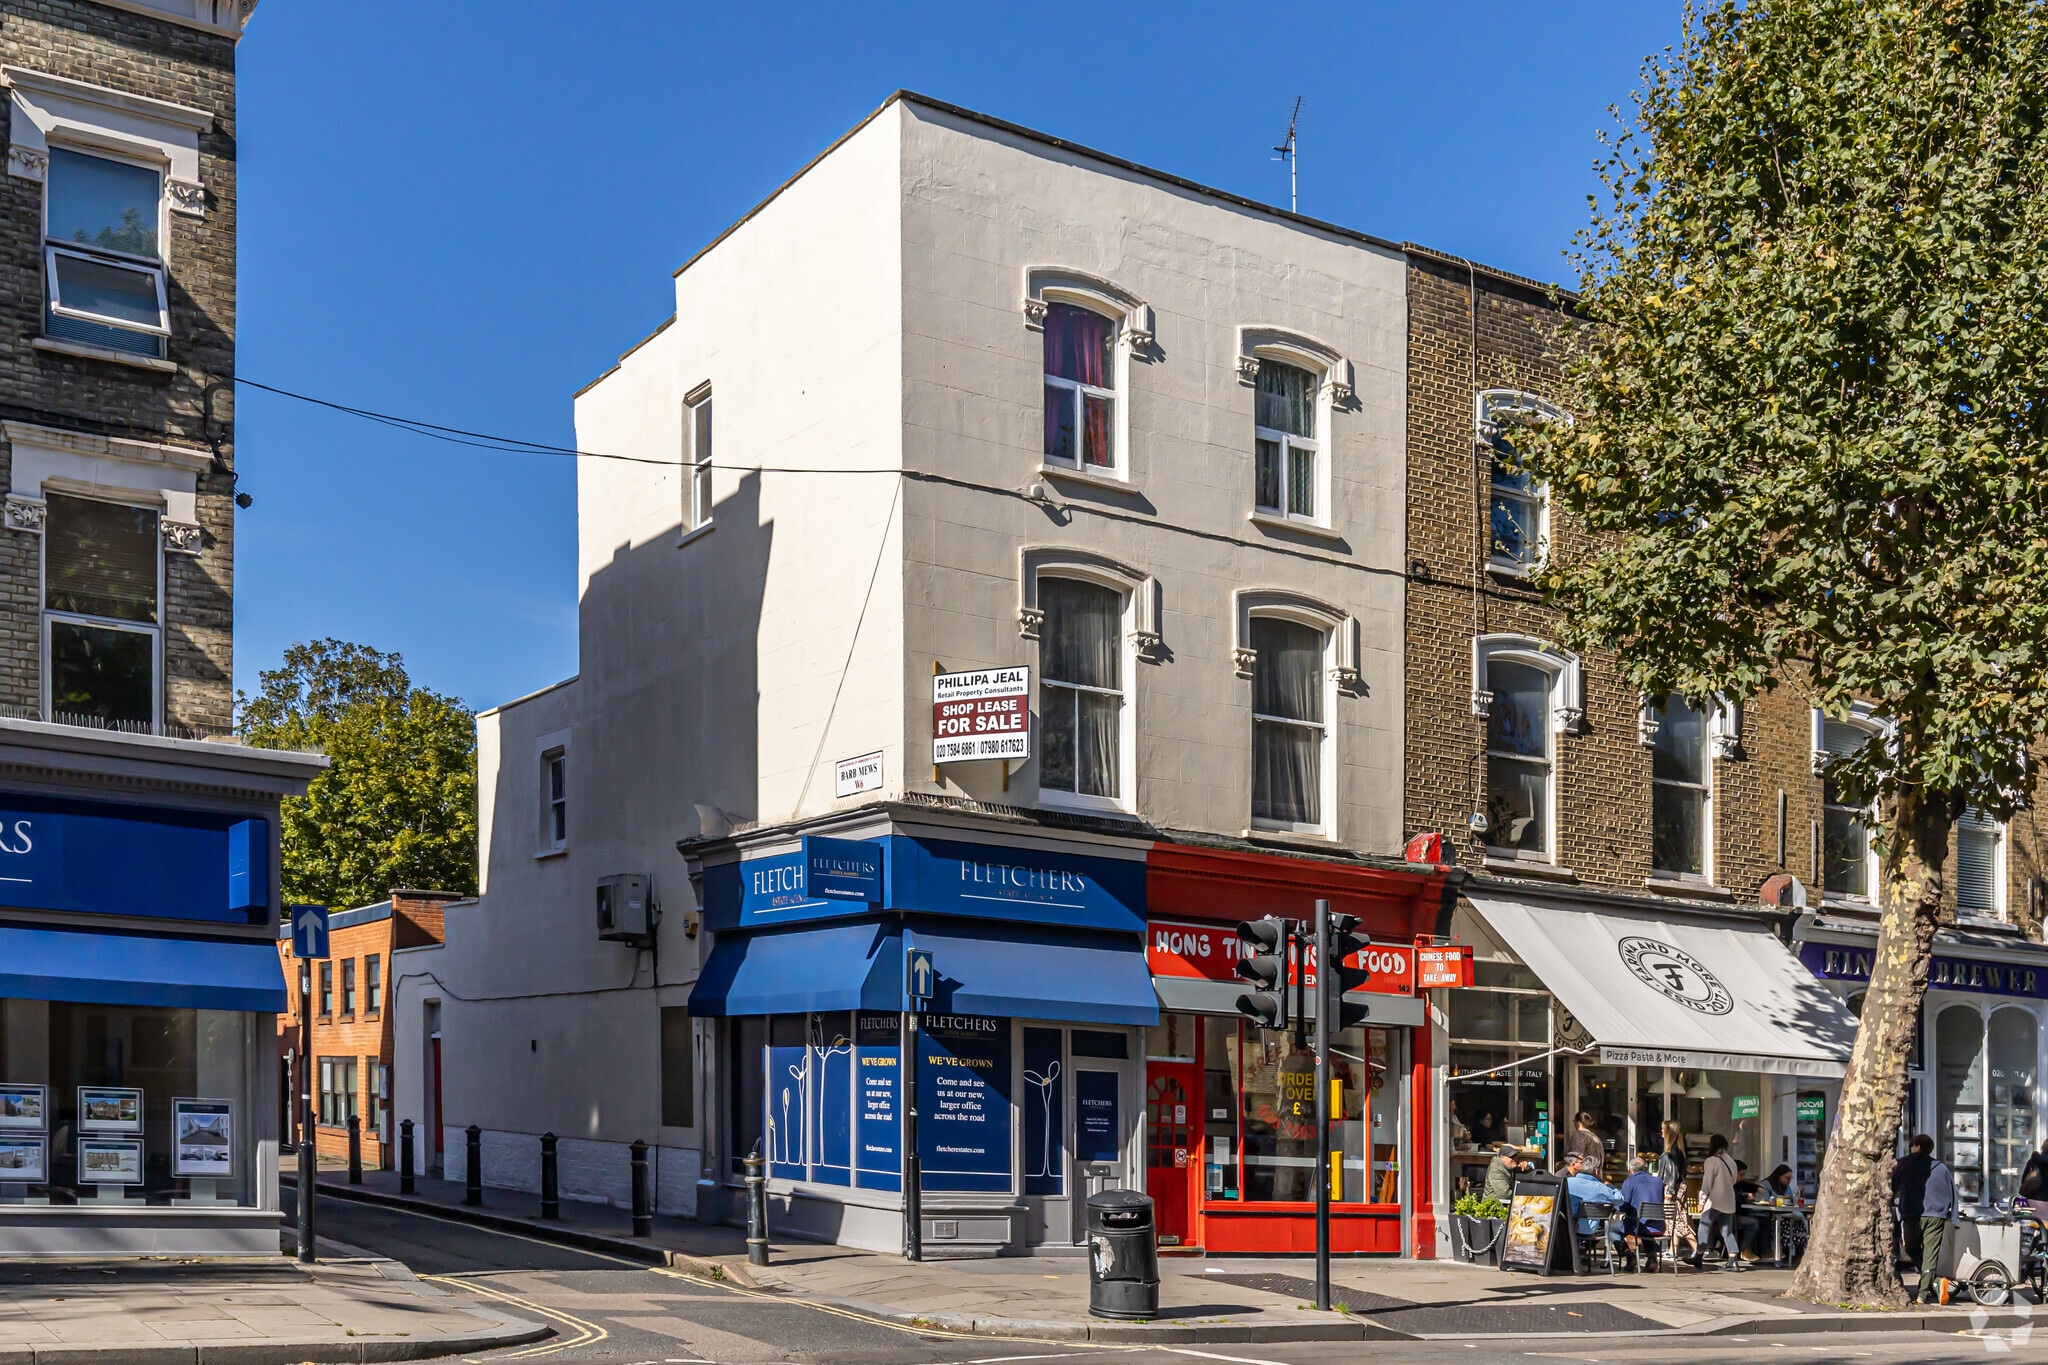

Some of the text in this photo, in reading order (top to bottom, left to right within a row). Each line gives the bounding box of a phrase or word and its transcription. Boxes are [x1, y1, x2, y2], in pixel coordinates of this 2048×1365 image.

[938, 671, 1023, 689] PHILLIPA JEAL
[938, 685, 1024, 699] Retail Property Consultants
[942, 699, 1017, 716] SHOP LEASE
[938, 713, 1022, 735] FOR SALE
[936, 744, 946, 758] 020
[946, 742, 960, 757] 7584
[961, 741, 975, 755] 6861
[980, 739, 999, 754] 07980
[1000, 738, 1024, 753] 617623
[841, 768, 857, 781] BARB
[859, 762, 878, 776] MEWS
[855, 779, 864, 789] W6
[813, 858, 875, 873] FLETCHERS
[754, 865, 803, 895] FLETCH
[960, 860, 1085, 892] FLETCHERS
[1155, 929, 1211, 957] HONG
[1222, 937, 1255, 960] TIN
[1357, 949, 1406, 975] FOOD
[1420, 951, 1461, 962] CHINESE FOOD
[1436, 963, 1444, 972] TO
[1623, 940, 1722, 989] FARINA AND MORE
[1824, 950, 2036, 991] FIN BREWER
[1423, 973, 1456, 982] TAKE AWAY
[1398, 984, 1410, 992] 142
[1663, 988, 1728, 1012] ESTD 2017
[860, 1017, 898, 1030] FLETCHERS
[925, 1015, 997, 1032] FLETCHERS
[878, 1057, 897, 1067] GROWN
[928, 1056, 993, 1068] WE'VE GROWN
[1606, 1050, 1686, 1064] Pizza Pasta & More
[1526, 1070, 1543, 1078] ITALY
[936, 1076, 985, 1088] Come and see
[937, 1089, 946, 1097] us
[947, 1089, 953, 1097] at
[968, 1091, 985, 1100] new,
[940, 1100, 982, 1111] larger office
[1082, 1099, 1112, 1107] FLETCHERS
[957, 1112, 968, 1121] the
[970, 1113, 985, 1122] road
[936, 1145, 985, 1154] fletcherestates.com
